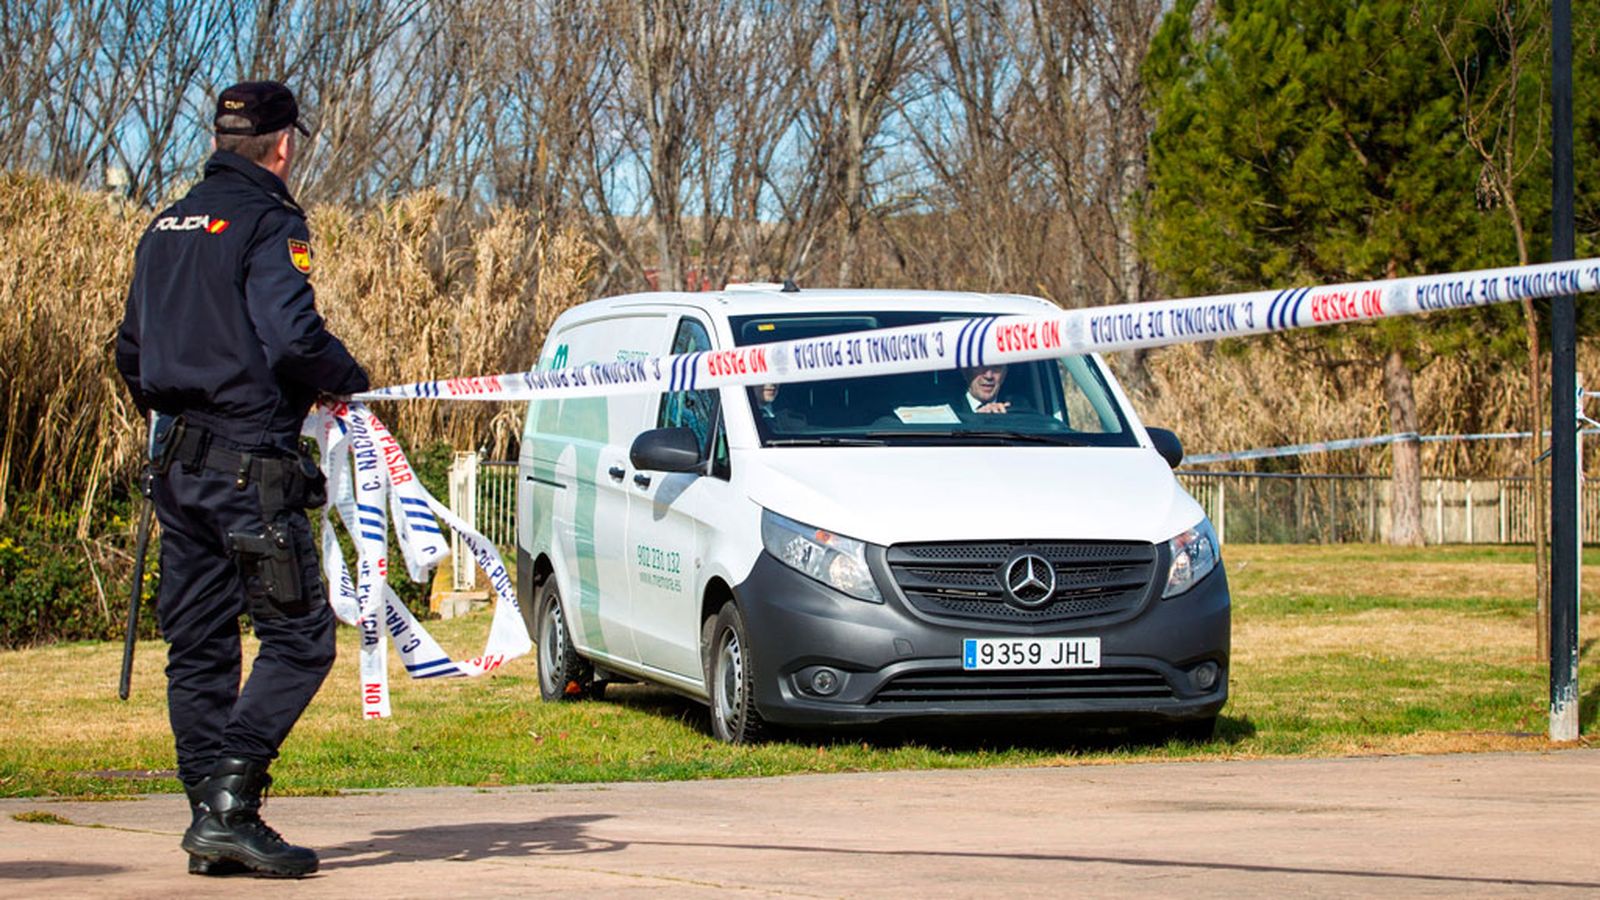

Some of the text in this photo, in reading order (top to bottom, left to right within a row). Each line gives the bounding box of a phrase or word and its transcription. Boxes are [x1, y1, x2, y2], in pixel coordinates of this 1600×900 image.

[151, 215, 210, 232] POLICIA
[1416, 280, 1475, 311] POLICIA
[1480, 277, 1501, 304] DE
[1504, 268, 1584, 299] NACIONAL
[1168, 303, 1238, 335] NACIONAL
[1310, 289, 1385, 322] NO PASAR
[996, 320, 1061, 352] NO PASAR
[1090, 314, 1143, 344] POLICIA
[1148, 311, 1165, 338] DE
[707, 347, 768, 376] NO PASAR
[794, 342, 844, 370] POLICIA
[846, 339, 863, 366] DE
[866, 332, 928, 363] NACIONAL
[590, 360, 646, 386] NACIONAL
[379, 436, 413, 487] PASAR
[980, 642, 1094, 665] 9359 JHL
[365, 683, 381, 704] NO
